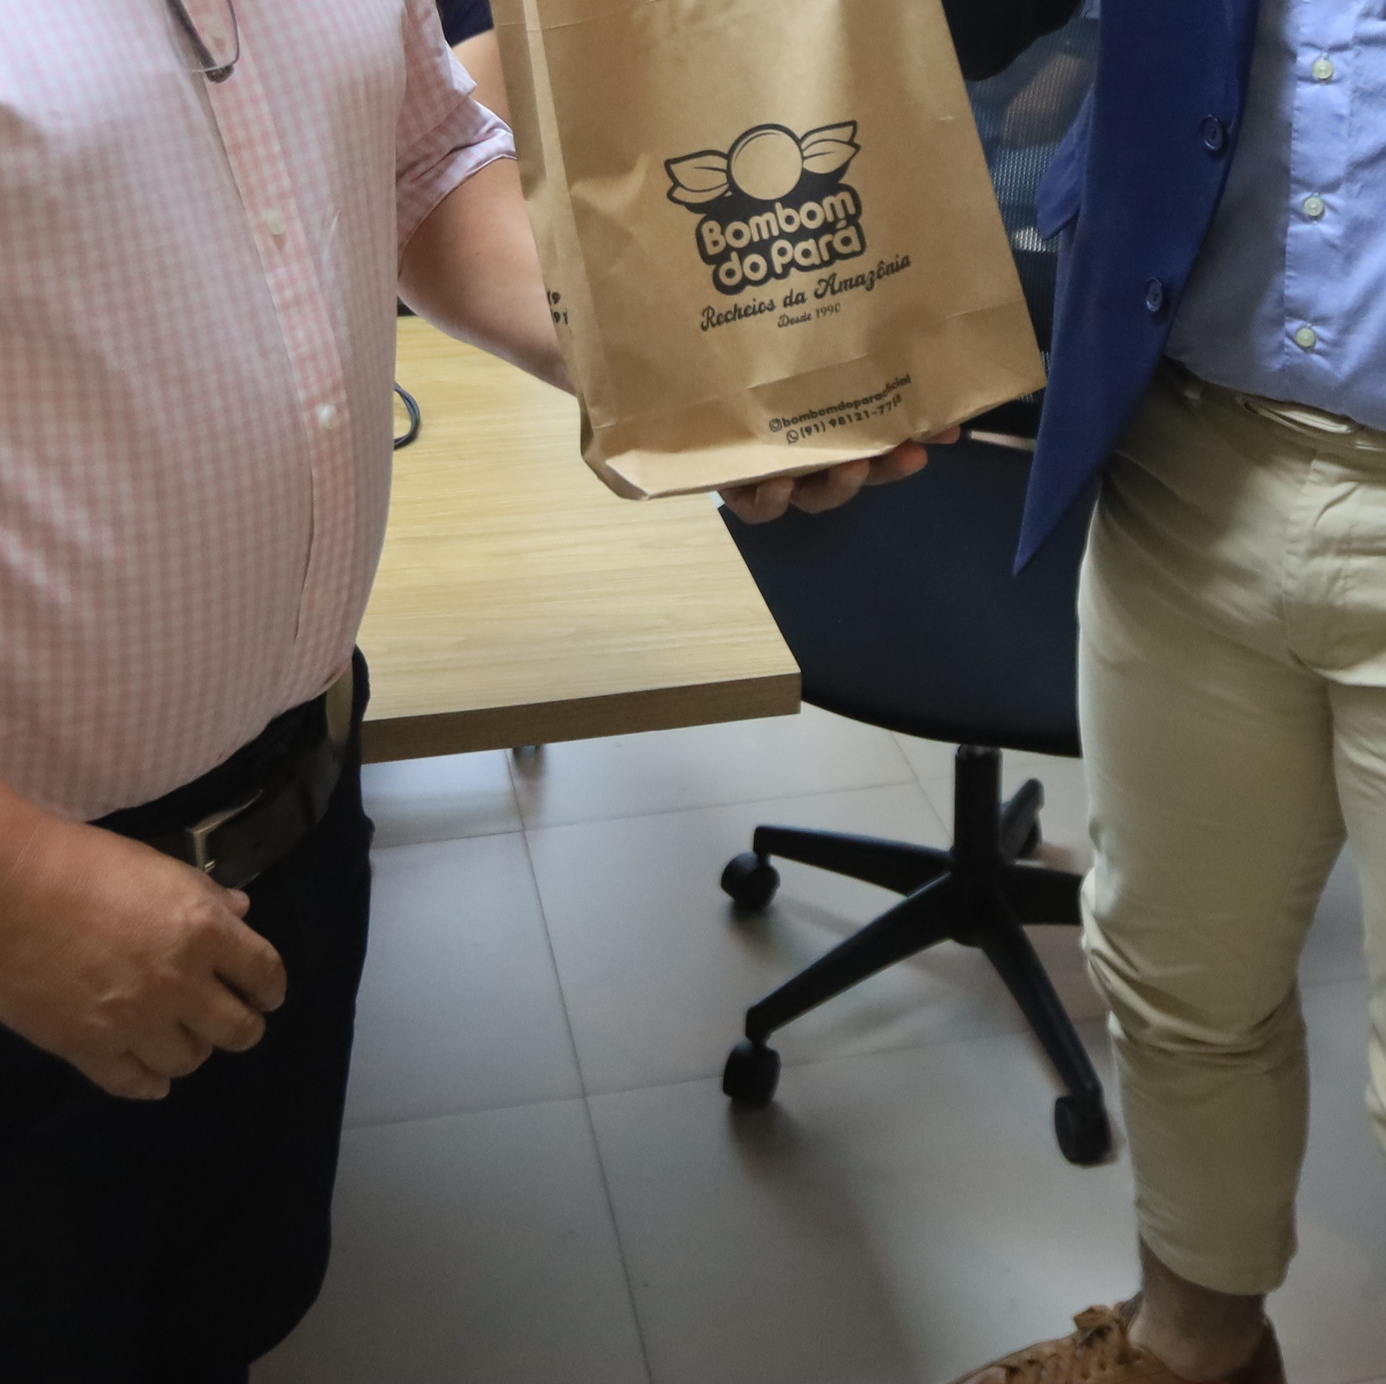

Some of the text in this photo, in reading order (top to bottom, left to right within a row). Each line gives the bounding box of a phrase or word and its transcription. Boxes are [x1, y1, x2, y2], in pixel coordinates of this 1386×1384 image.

[700, 190, 856, 256] Bombom
[718, 219, 862, 287] do Pará
[700, 254, 911, 332] Recheios da Amazônia
[777, 310, 812, 328] Desde
[800, 421, 826, 439] (91)
